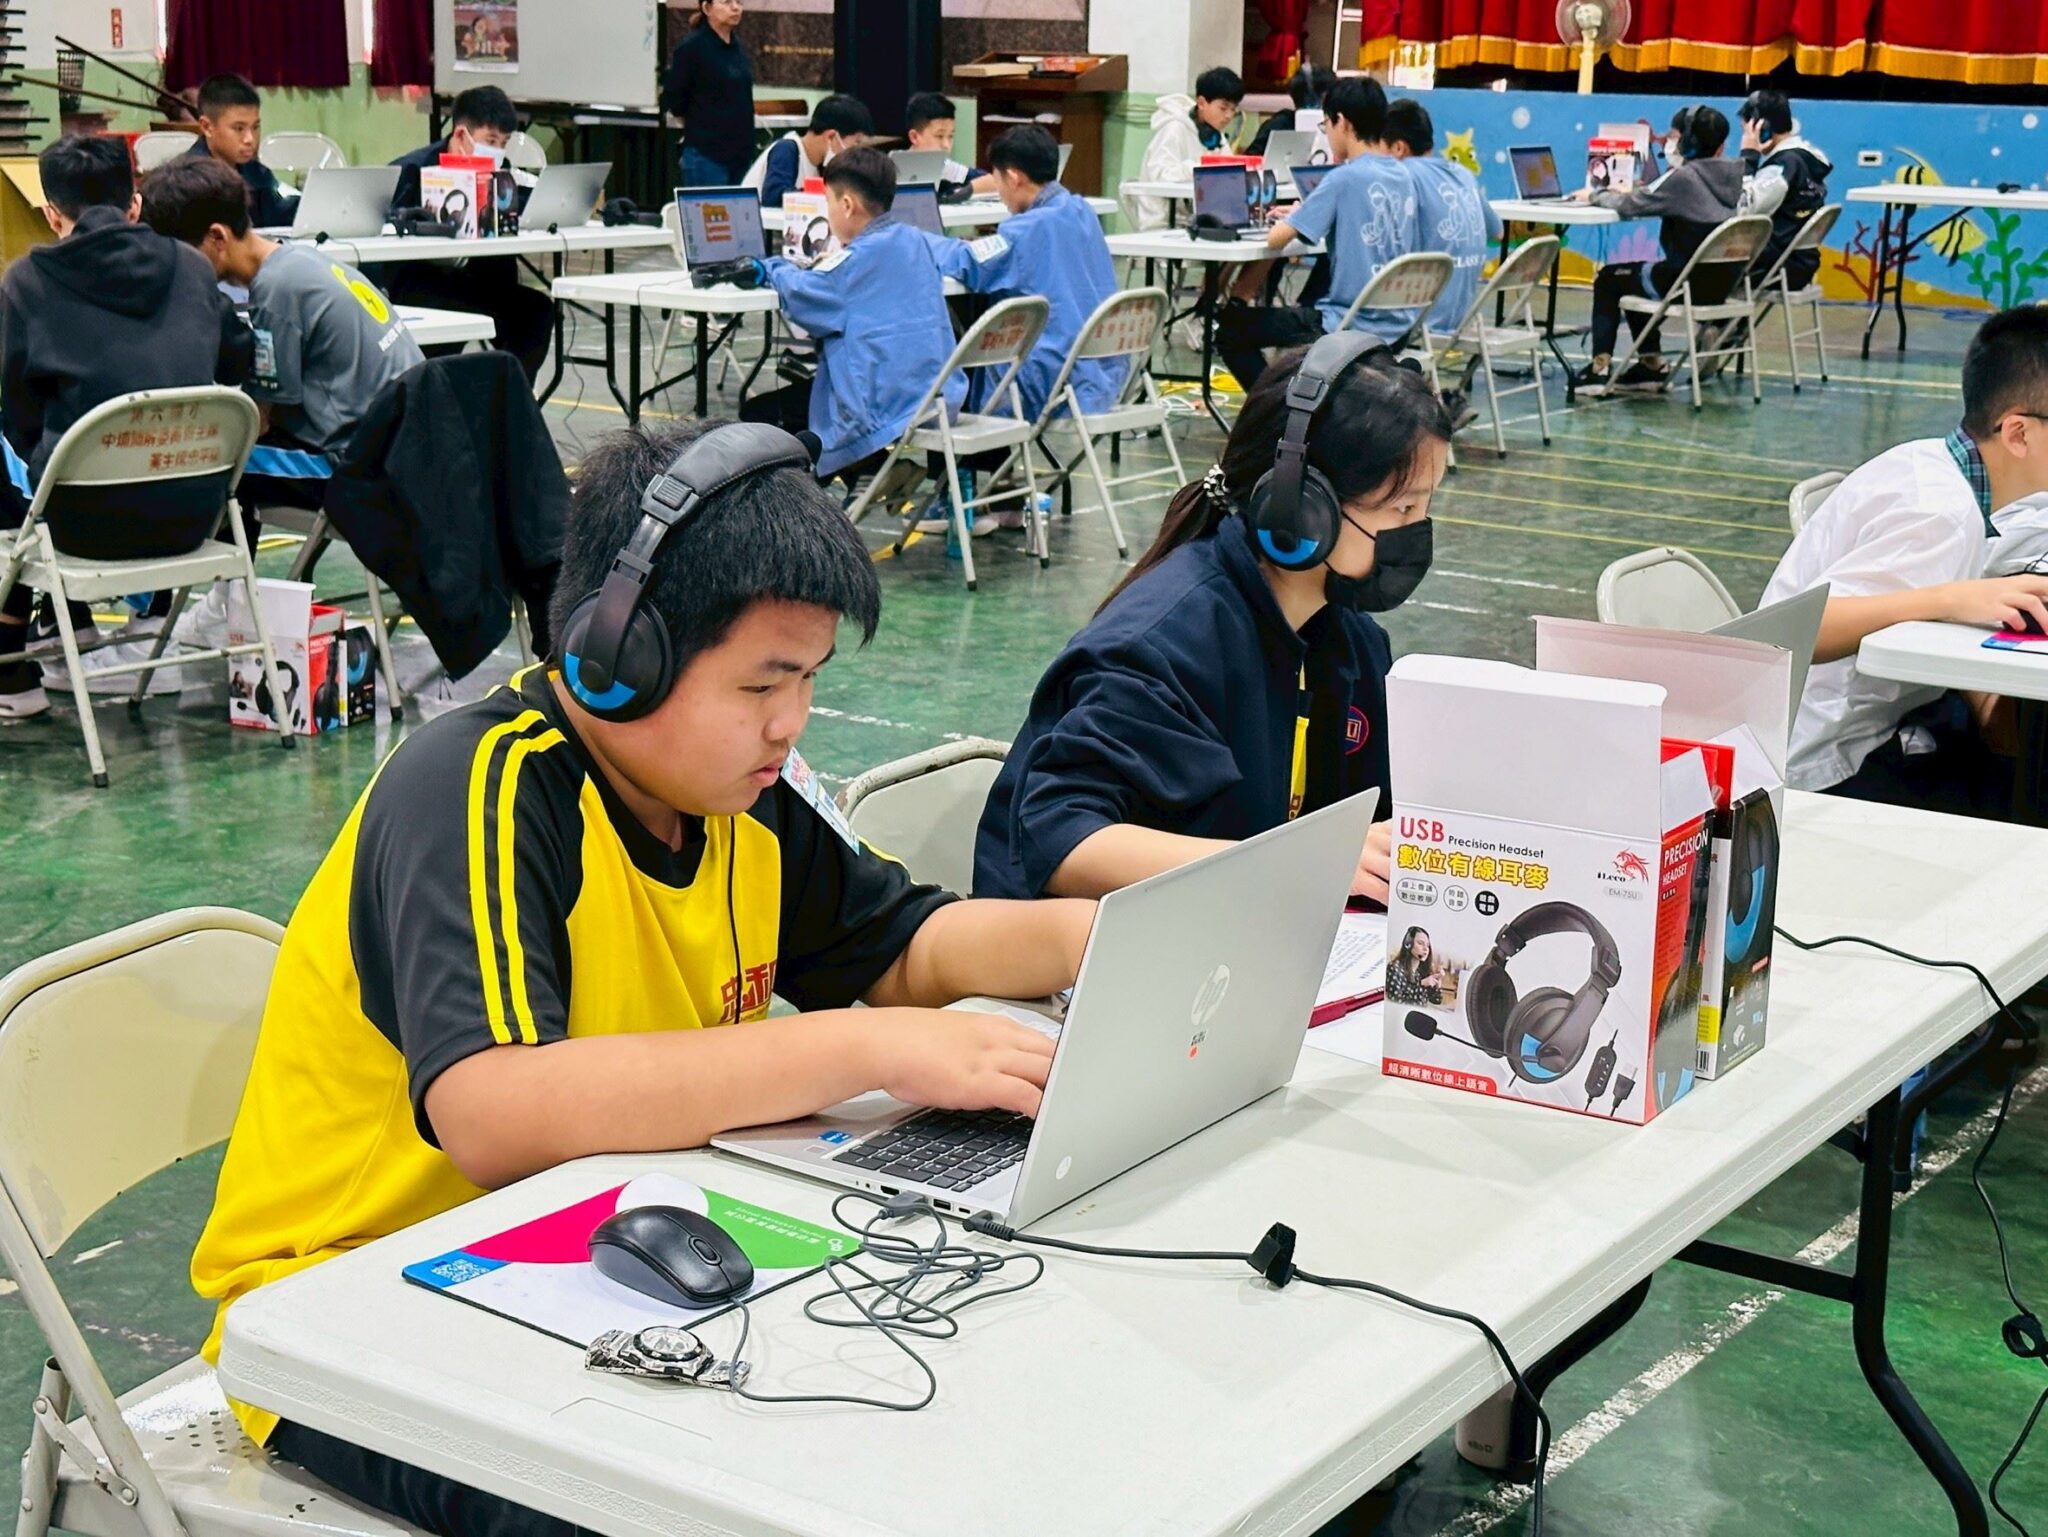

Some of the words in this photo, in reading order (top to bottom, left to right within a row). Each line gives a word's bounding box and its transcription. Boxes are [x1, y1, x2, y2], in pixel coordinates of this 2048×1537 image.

[1400, 816, 1445, 842] USB
[1448, 835, 1496, 851] Precision
[1499, 843, 1544, 858] Headset
[1664, 828, 1709, 868] PRECISION
[1397, 843, 1549, 890] 數位有線耳麥
[1662, 862, 1688, 886] HEADSET
